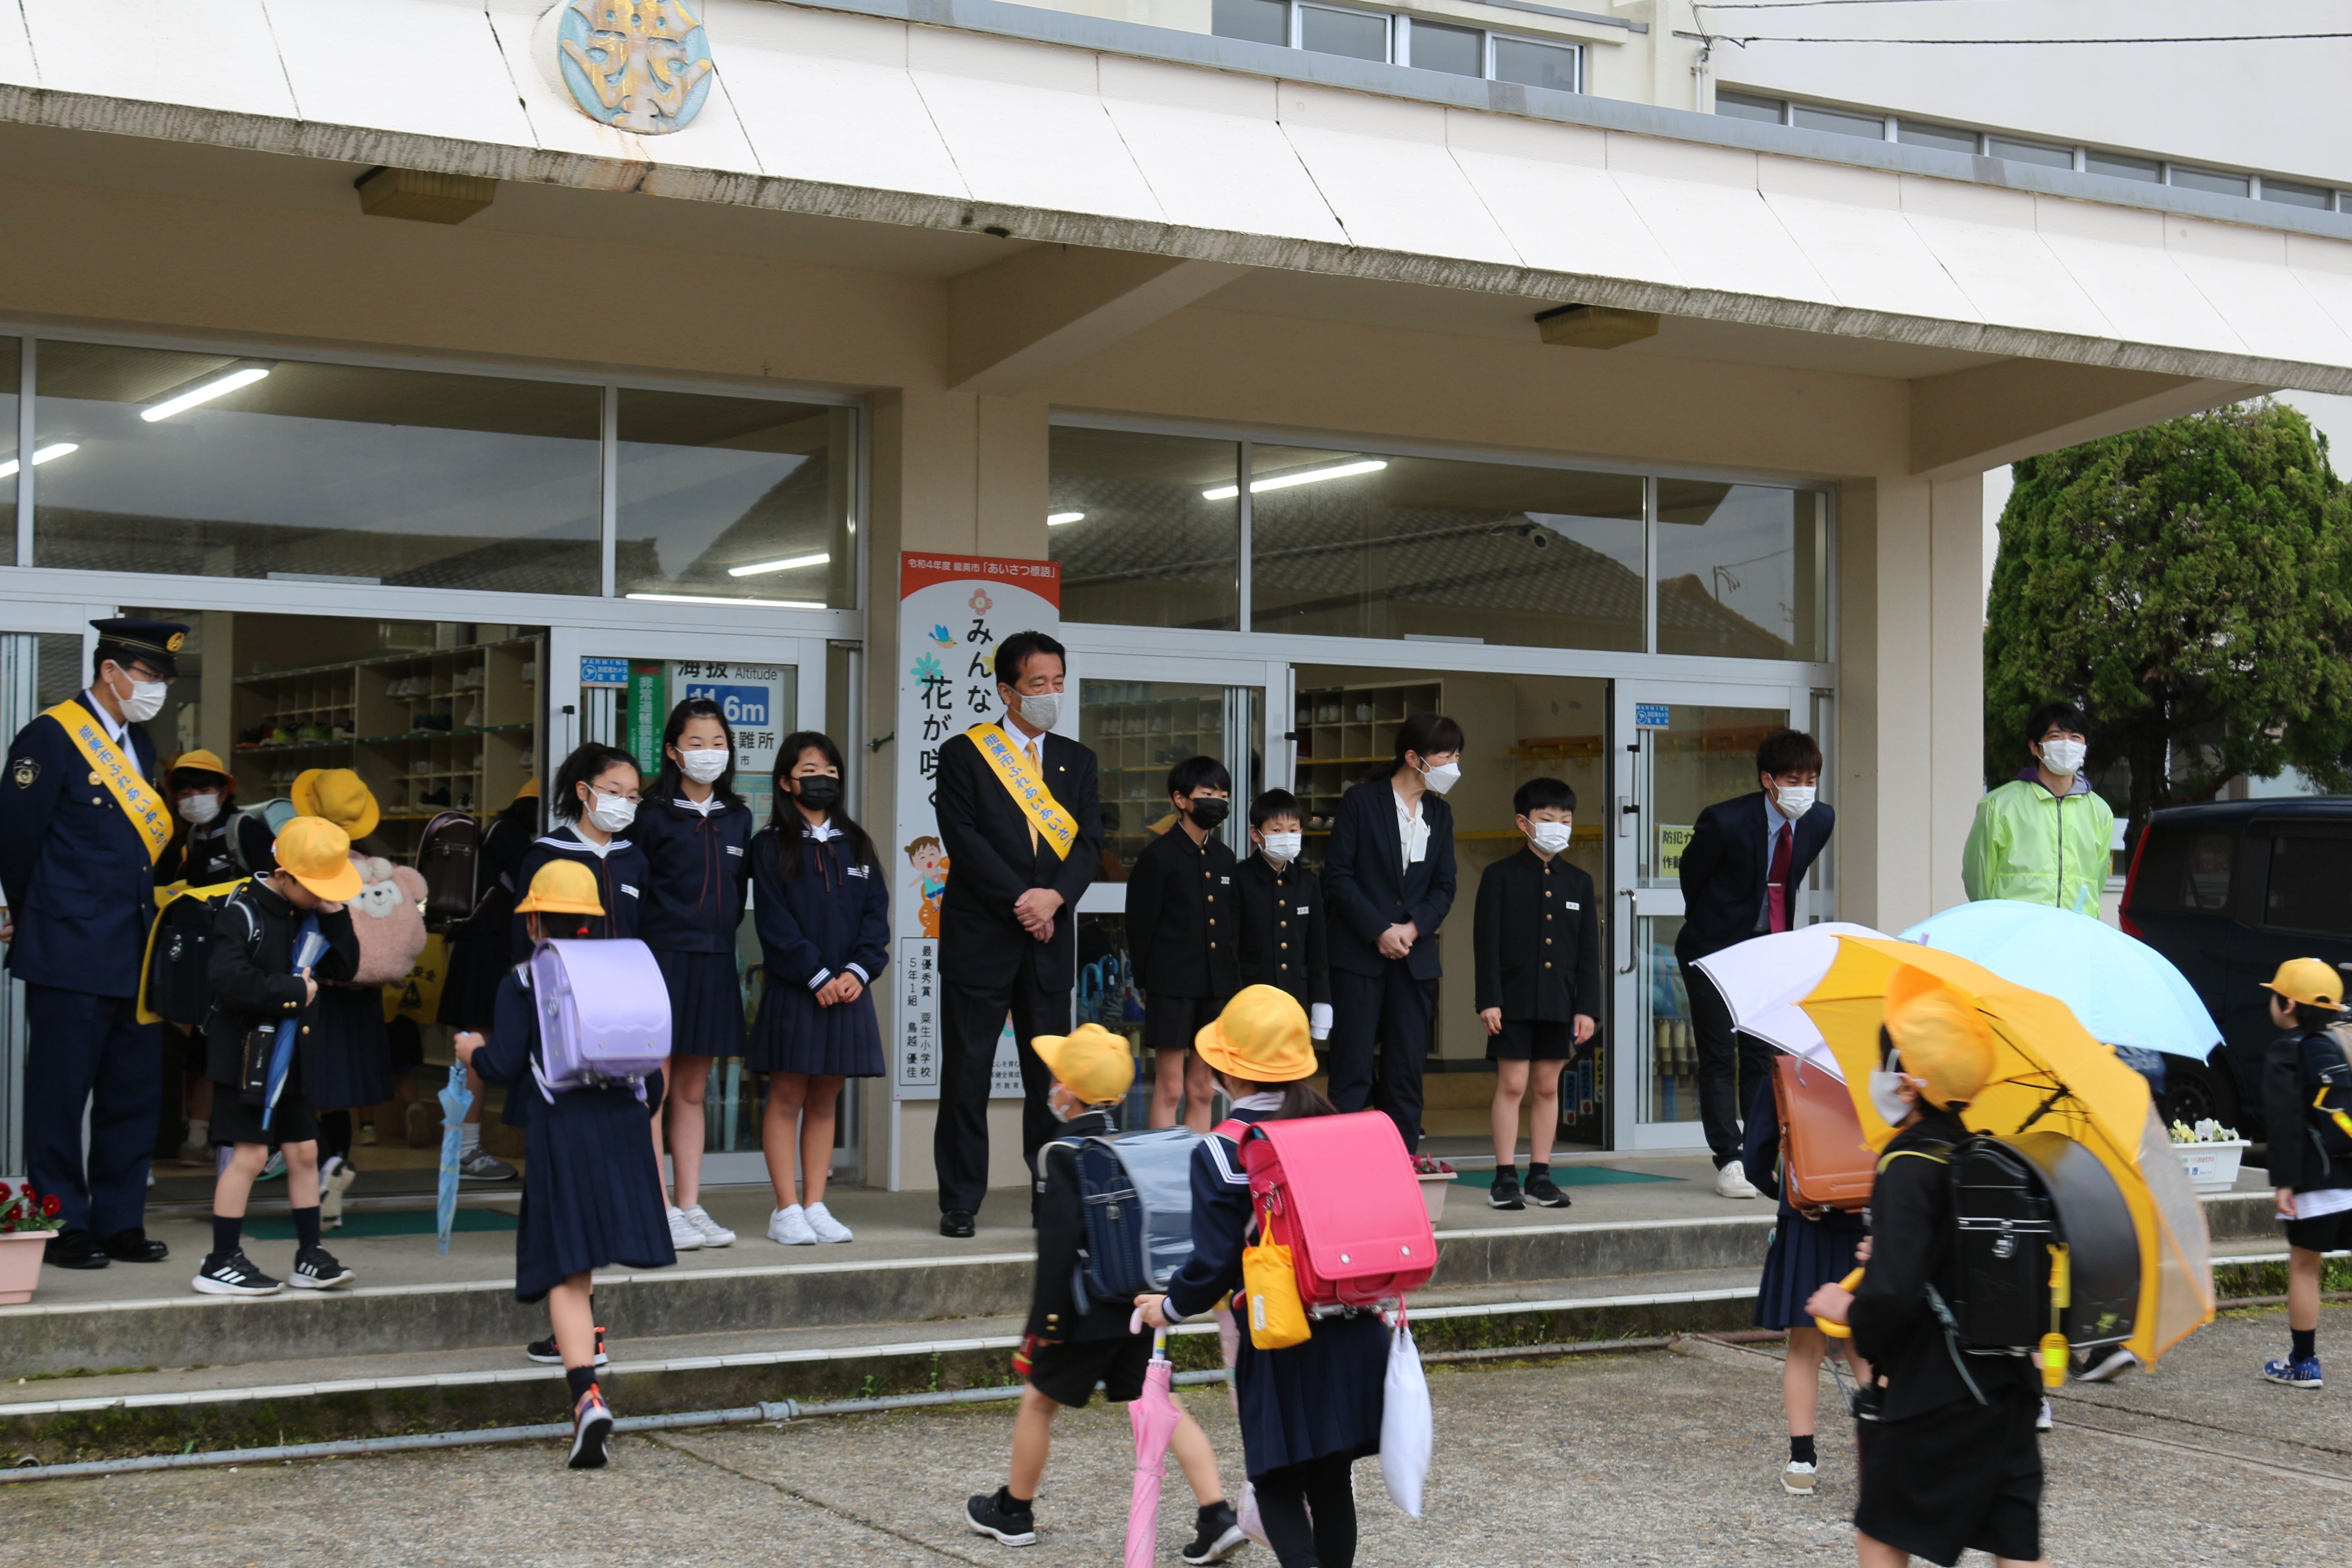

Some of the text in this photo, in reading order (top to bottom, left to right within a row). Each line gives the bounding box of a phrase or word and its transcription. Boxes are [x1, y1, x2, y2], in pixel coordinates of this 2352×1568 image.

[908, 559, 951, 571] 令和4年度
[954, 563, 980, 572] 能美市
[678, 661, 728, 678] 海抜
[735, 667, 777, 680] Altitude
[967, 619, 993, 730] みんな
[907, 958, 917, 1006] 5年1組
[920, 946, 931, 1077] 最優秀賞 粟生小学校
